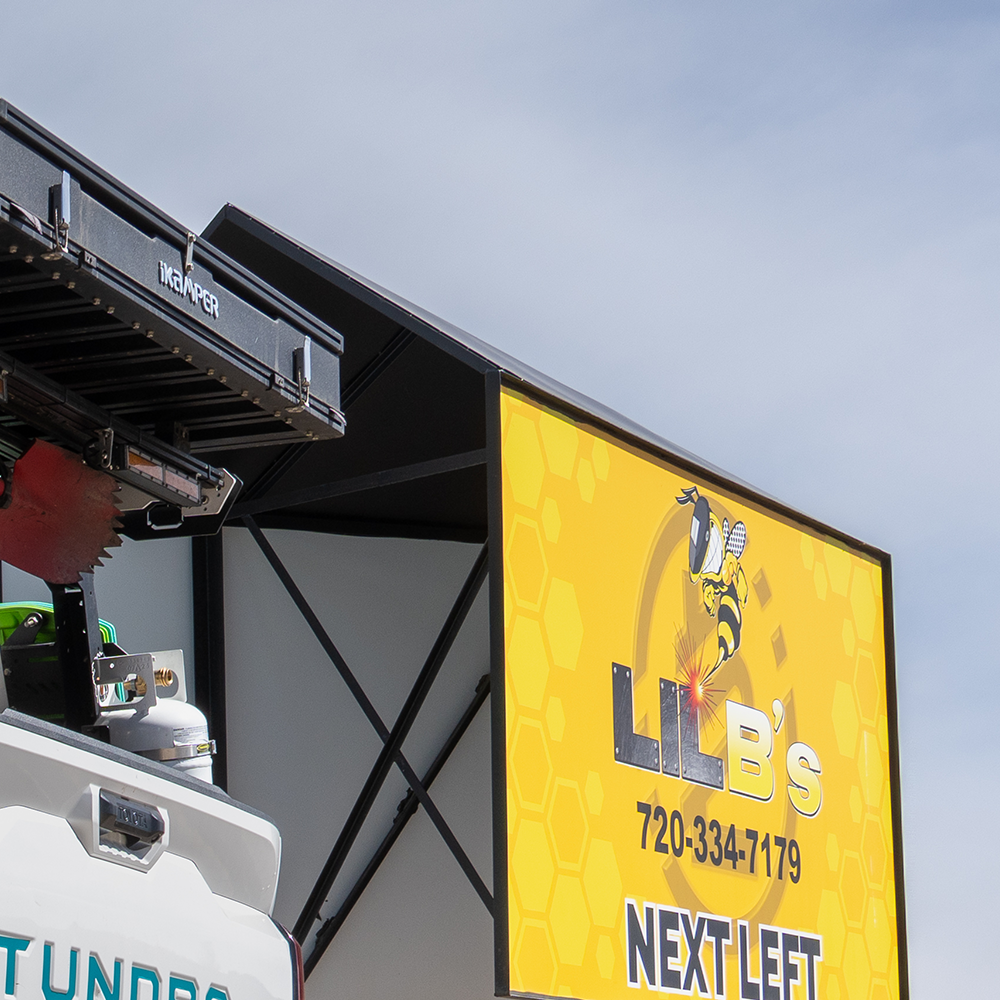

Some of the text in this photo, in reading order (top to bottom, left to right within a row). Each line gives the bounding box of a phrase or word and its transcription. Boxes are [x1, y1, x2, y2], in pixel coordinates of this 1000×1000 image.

[611, 661, 725, 791] LIL
[118, 806, 148, 829] TOYOTA
[636, 801, 802, 885] 720-334-7179
[624, 897, 733, 1000] NEXT
